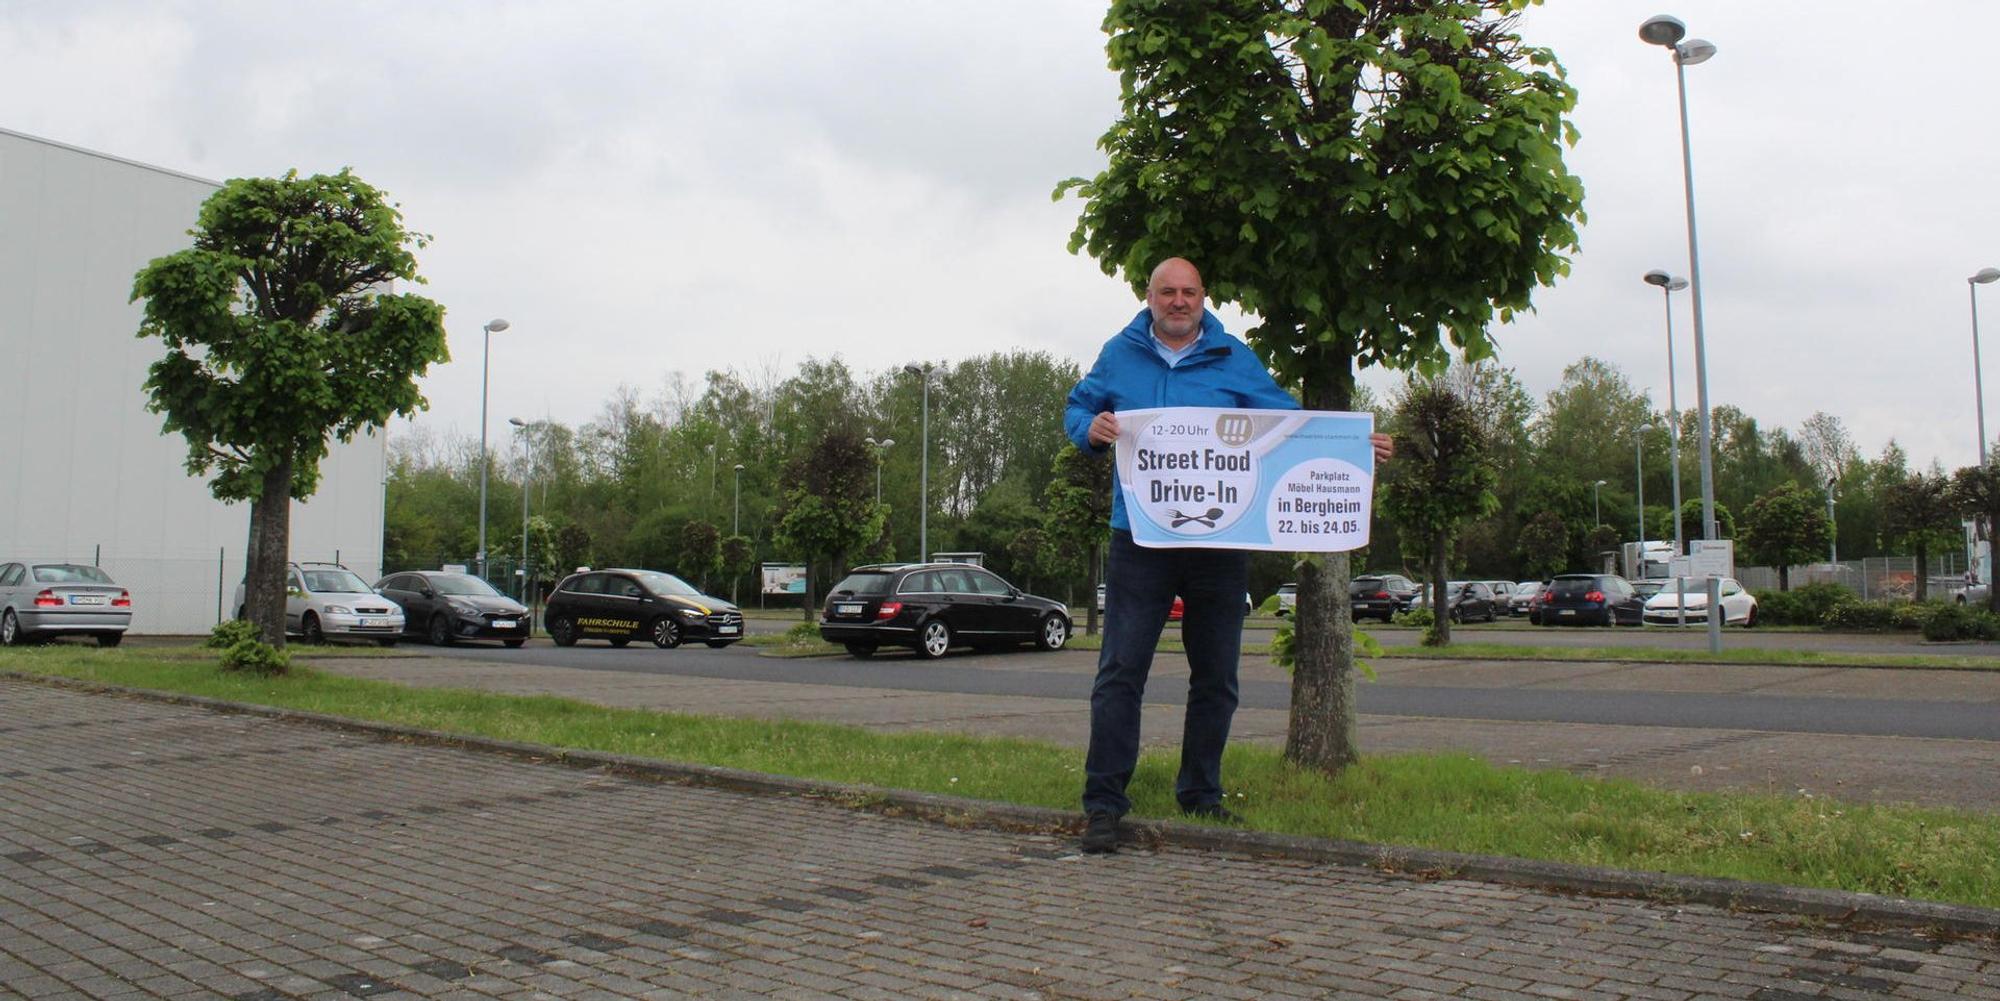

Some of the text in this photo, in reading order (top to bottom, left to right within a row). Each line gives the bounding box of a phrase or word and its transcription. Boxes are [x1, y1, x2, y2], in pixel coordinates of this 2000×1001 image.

[1152, 425, 1209, 436] 12-20 Uhr
[1137, 448, 1250, 471] Street Food
[1310, 471, 1350, 482] Parkplatz
[1150, 479, 1237, 503] Drive-In
[1288, 483, 1361, 493] Möbel Hausmann
[1278, 497, 1361, 517] in Bergheim
[1278, 520, 1360, 534] 22. bis 24.05.
[577, 617, 640, 629] FAHRSCHULE
